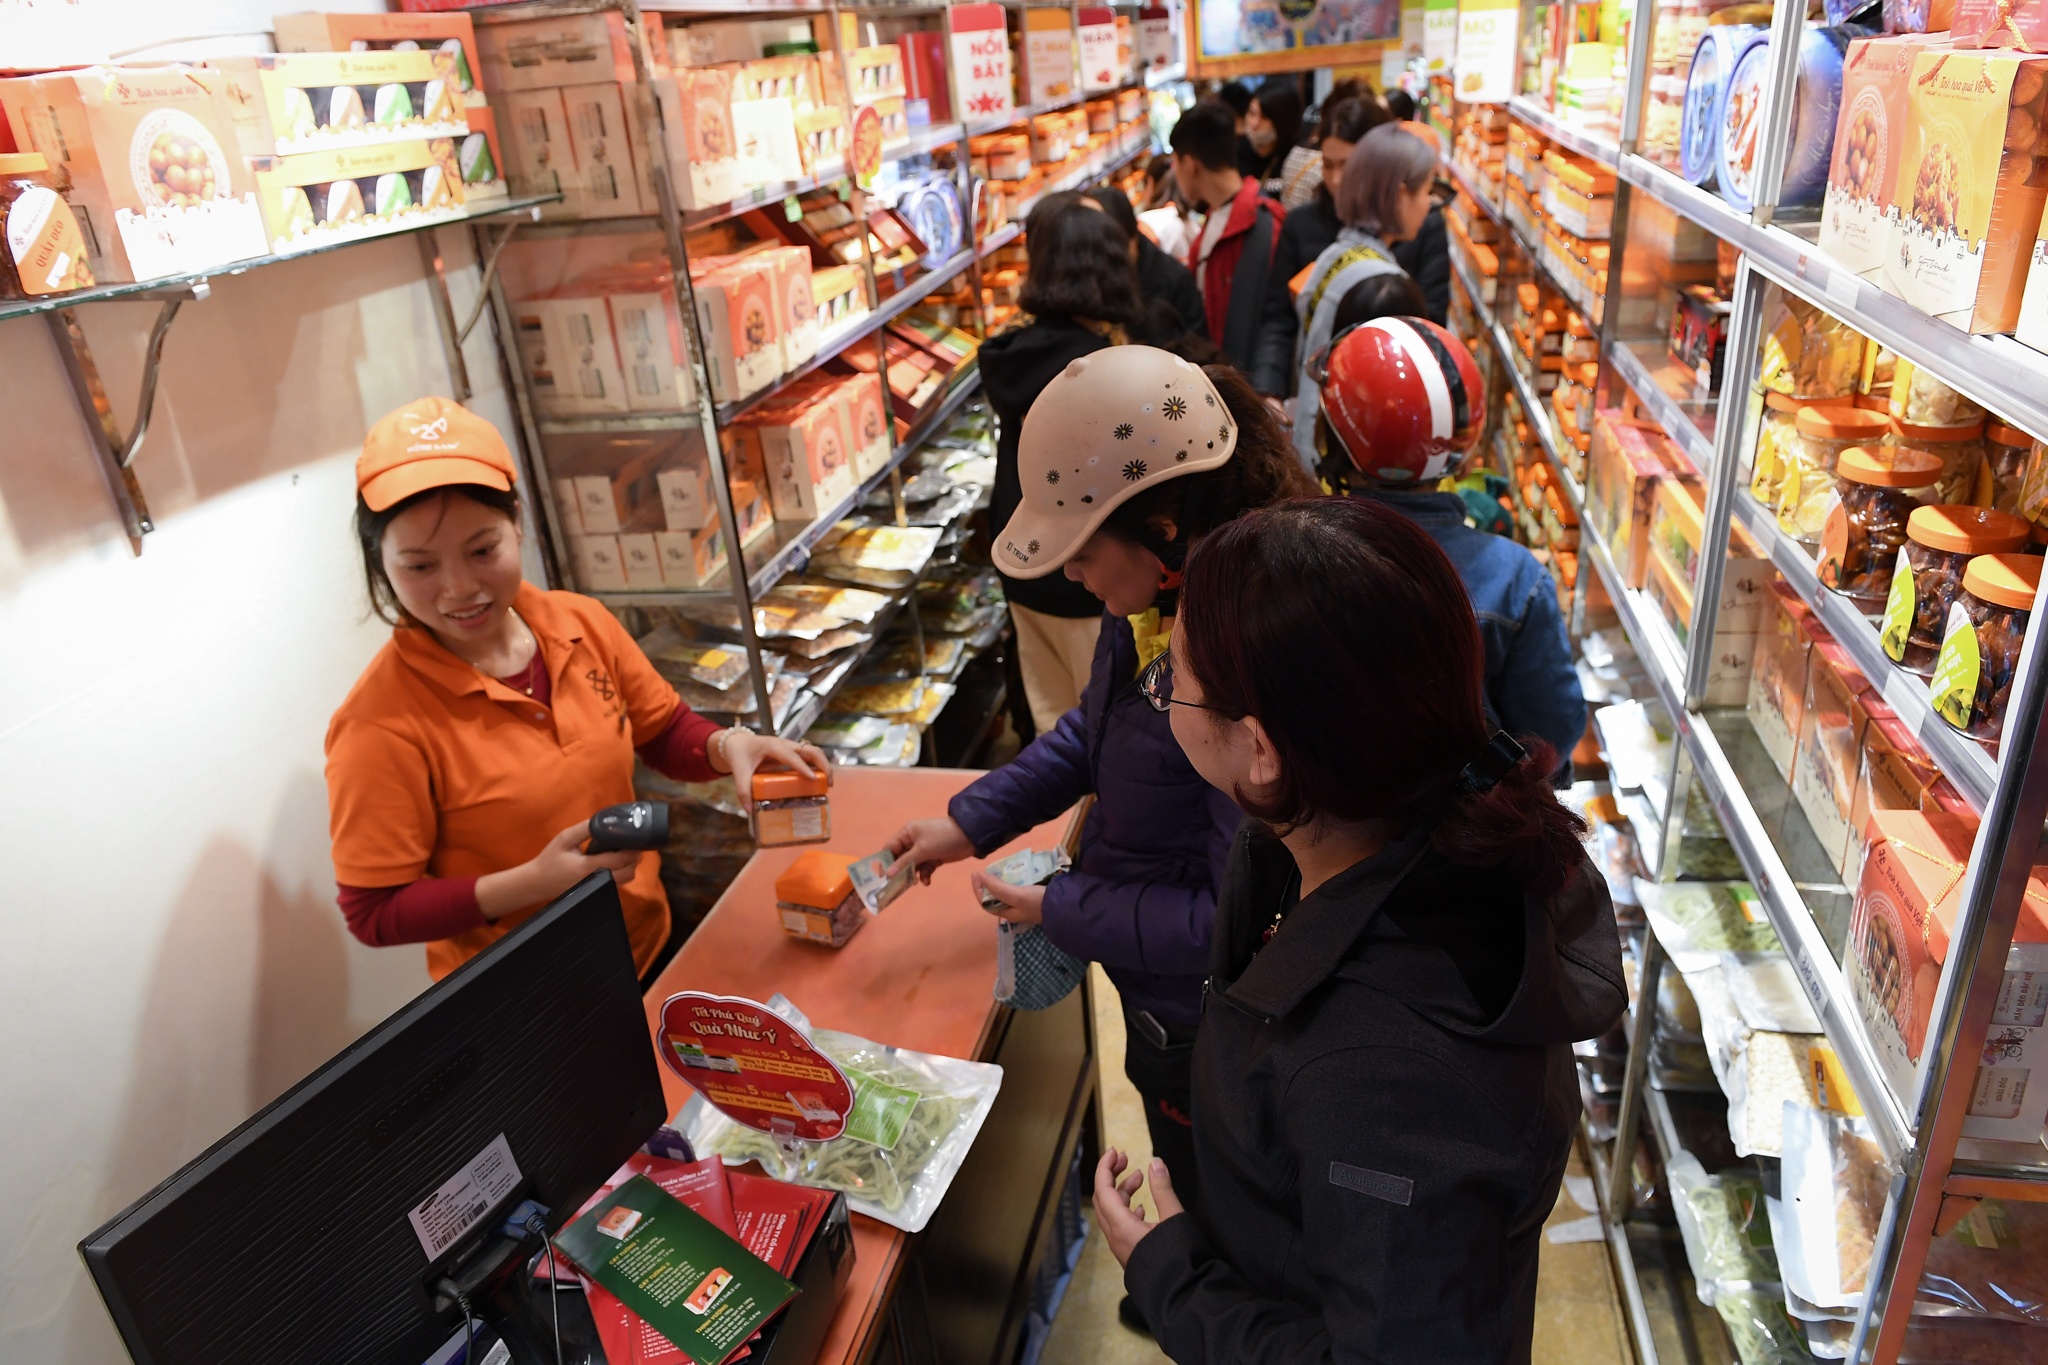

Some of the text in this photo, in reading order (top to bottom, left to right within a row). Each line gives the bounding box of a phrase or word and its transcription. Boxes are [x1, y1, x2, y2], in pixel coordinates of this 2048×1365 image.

[970, 29, 1003, 56] NỔI
[973, 63, 1004, 83] BẬT
[36, 220, 63, 267] QUẤT DẺO
[1012, 547, 1029, 564] TRUM
[1885, 865, 1923, 928] Tinh hoa quà Việt
[2014, 994, 2027, 1006] DẺO
[691, 1003, 760, 1027] Tết Phú Quý
[2011, 1007, 2024, 1021] MẬN
[689, 1017, 776, 1044] Quà Như Ý
[742, 1046, 813, 1065] HÓA ĐƠN 3 TRIỆU
[746, 1084, 758, 1095] 5
[760, 1090, 784, 1100] TRIỆU
[775, 1213, 787, 1230] CÔNG
[769, 1237, 779, 1247] CỔ
[694, 1302, 729, 1334] THỊNH VƯỢNG
